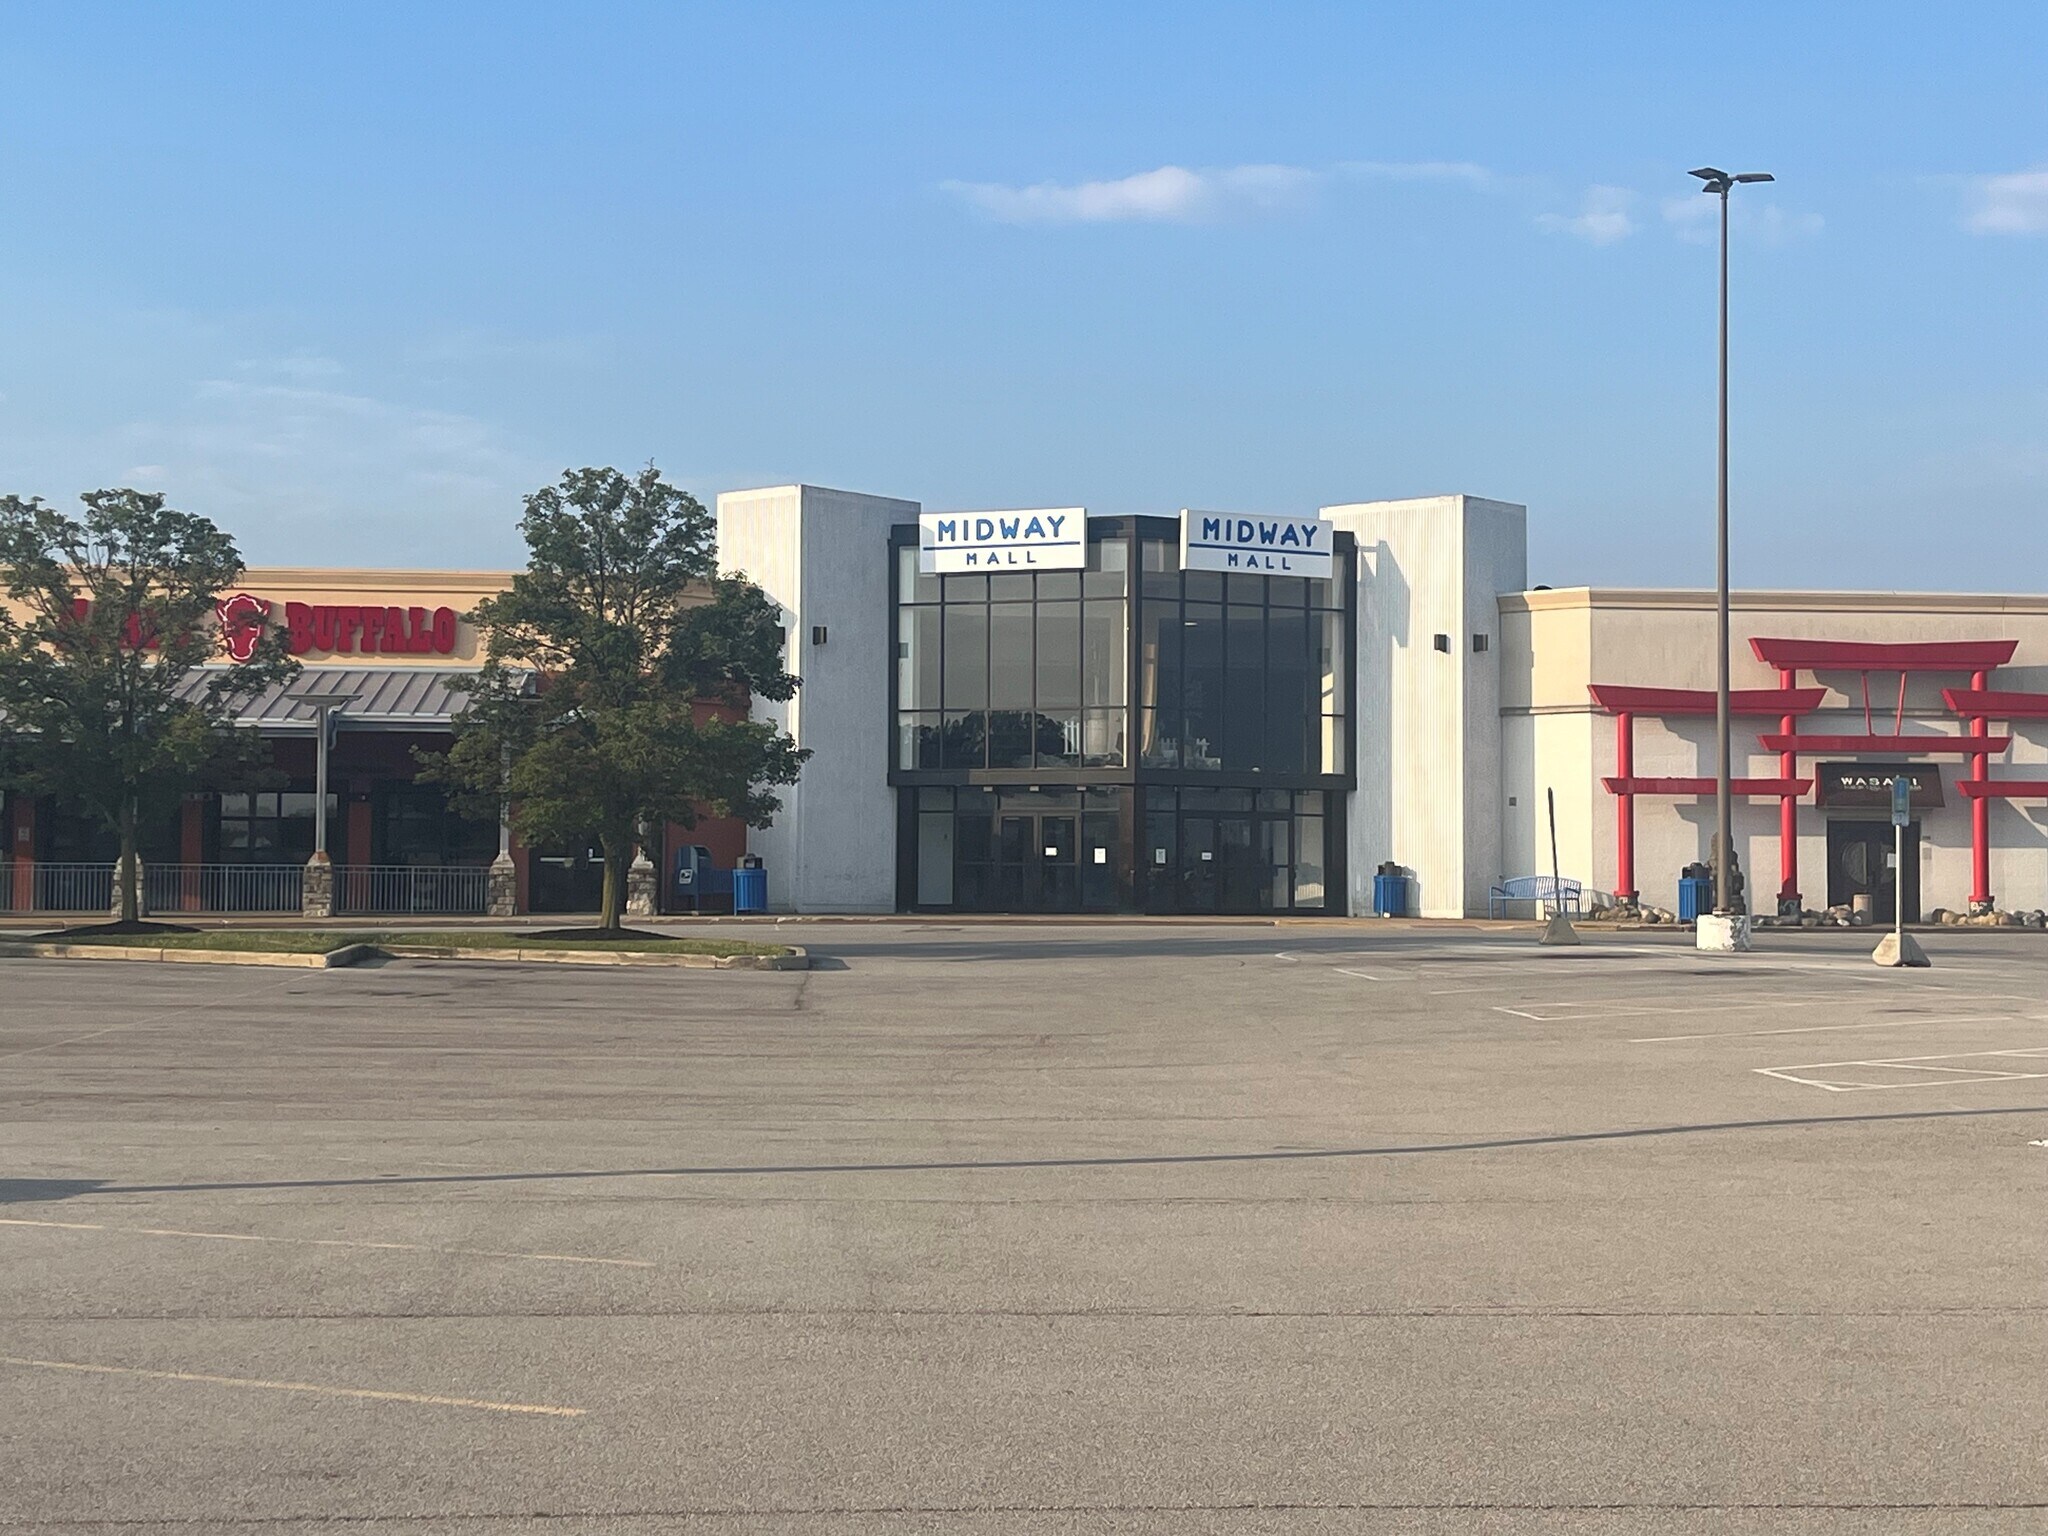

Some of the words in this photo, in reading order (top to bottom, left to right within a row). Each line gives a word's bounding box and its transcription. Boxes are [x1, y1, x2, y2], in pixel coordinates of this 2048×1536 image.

[938, 516, 1066, 541] MIDWAY
[1202, 518, 1317, 548] MIDWAY
[966, 551, 1037, 565] MALL
[1227, 553, 1292, 570] MALL
[286, 601, 456, 654] BUFFALO
[1840, 776, 1918, 786] WASAI
